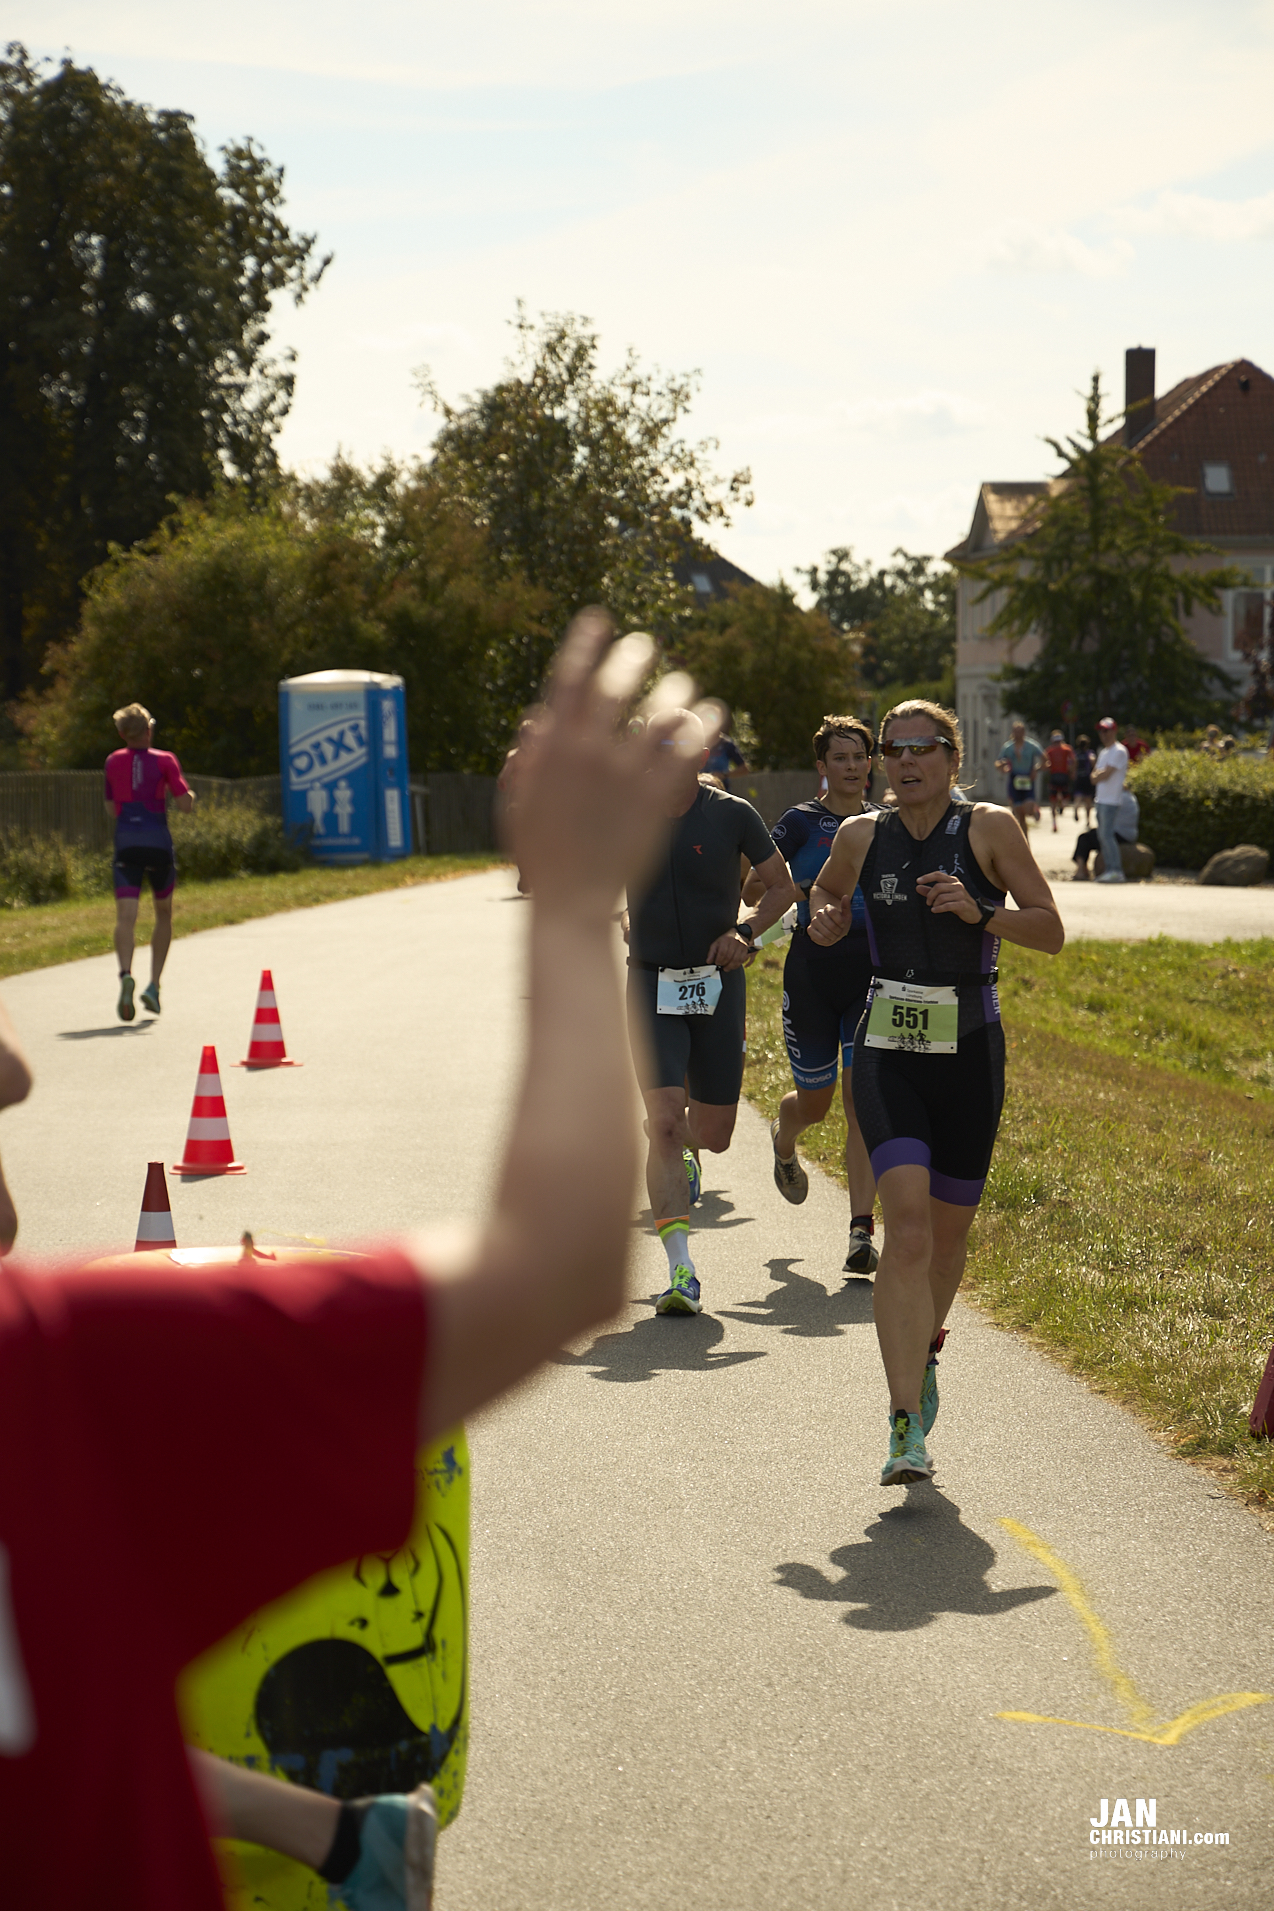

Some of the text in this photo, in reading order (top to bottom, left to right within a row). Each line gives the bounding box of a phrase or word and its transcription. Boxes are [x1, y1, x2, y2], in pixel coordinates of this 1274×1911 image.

[678, 982, 706, 1000] 276
[891, 1004, 929, 1031] 551
[782, 1014, 802, 1059] MLP
